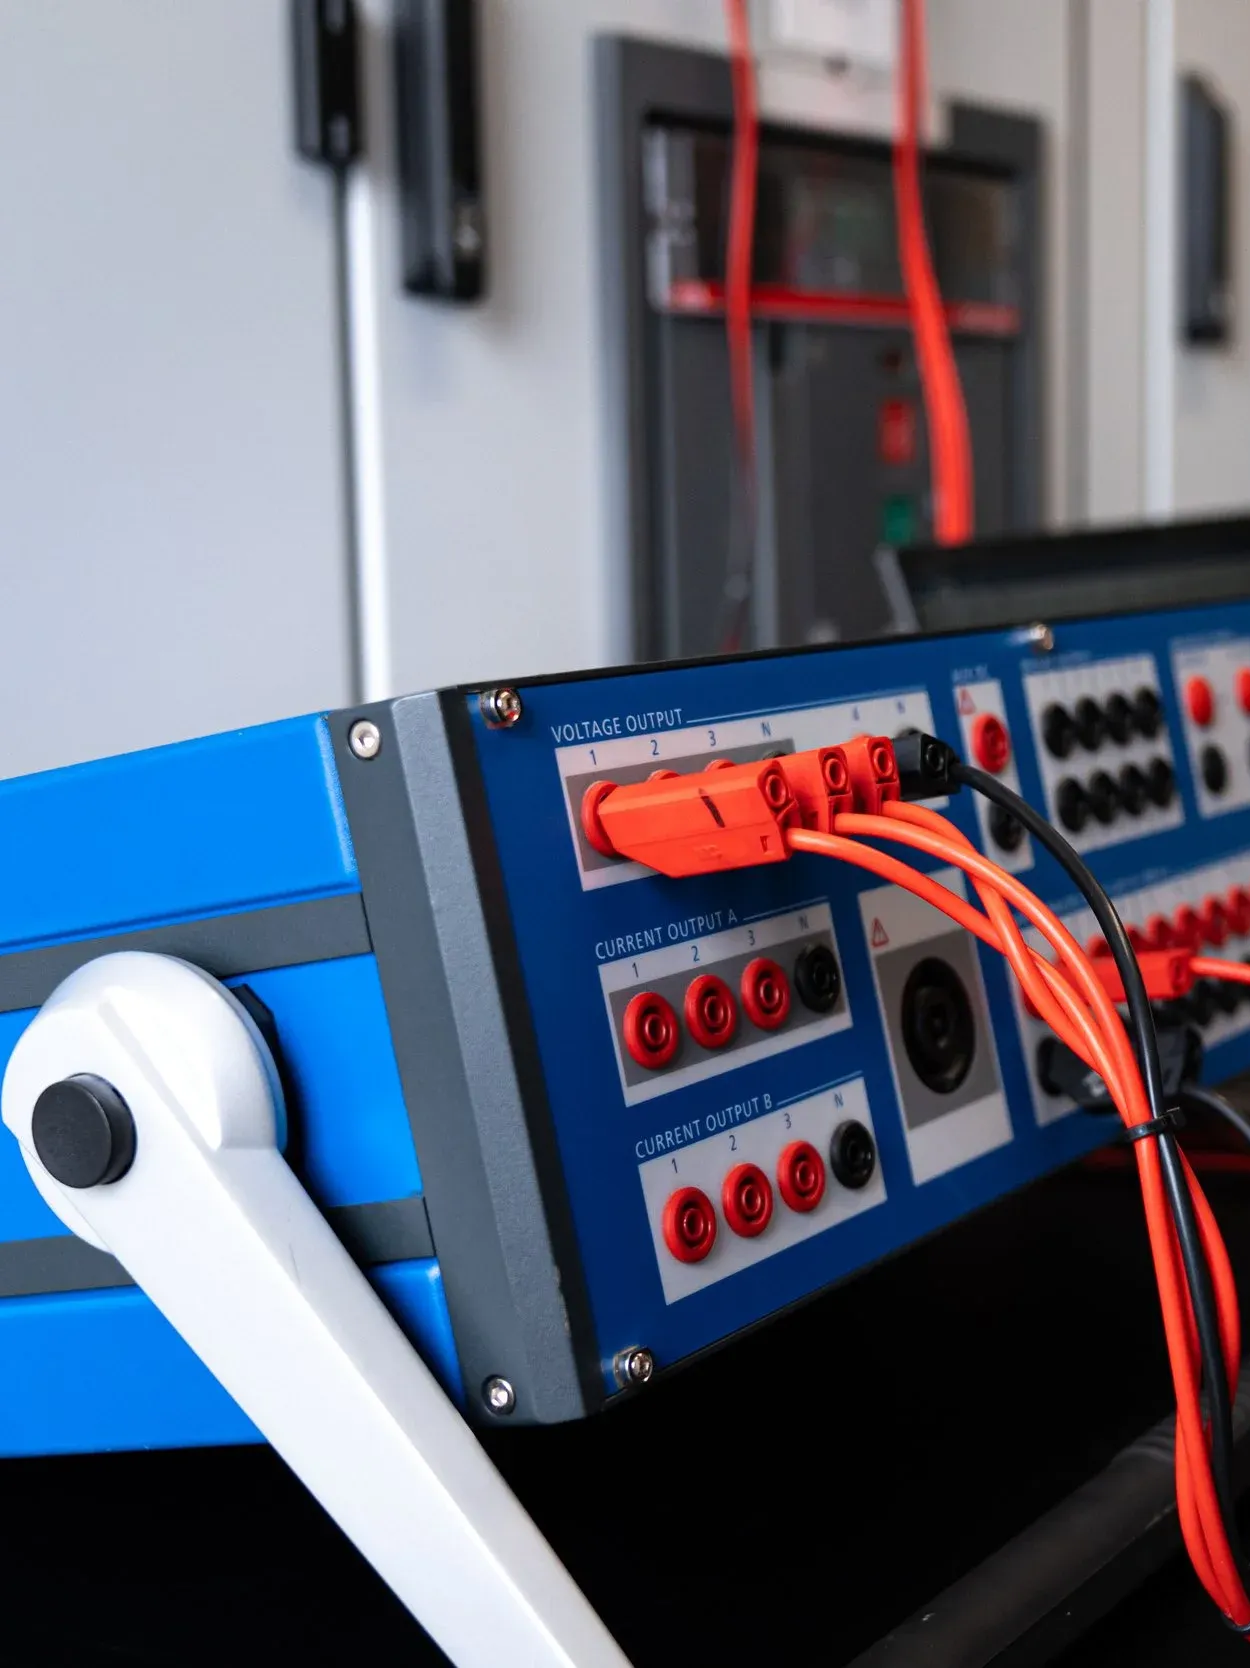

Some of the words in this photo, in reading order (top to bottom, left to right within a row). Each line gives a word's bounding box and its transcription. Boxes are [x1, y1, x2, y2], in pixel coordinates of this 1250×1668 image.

[551, 717, 621, 743] VOLTAGE
[626, 708, 682, 733] OUTPUT
[589, 749, 597, 766] 1
[650, 739, 659, 756] 2
[708, 730, 717, 747] 3
[760, 722, 771, 738] N
[595, 927, 662, 960] CURRENT
[667, 911, 723, 941] OUTPUT
[728, 909, 738, 925] A
[632, 962, 639, 978] 1
[691, 945, 700, 962] 2
[748, 930, 755, 946] 3
[635, 1119, 700, 1159] CURRENT
[706, 1096, 759, 1132] OUTPUT
[764, 1093, 773, 1110] B
[671, 1158, 678, 1174] 1
[729, 1134, 737, 1151] 2
[784, 1113, 792, 1130] 3
[833, 1091, 844, 1107] N
